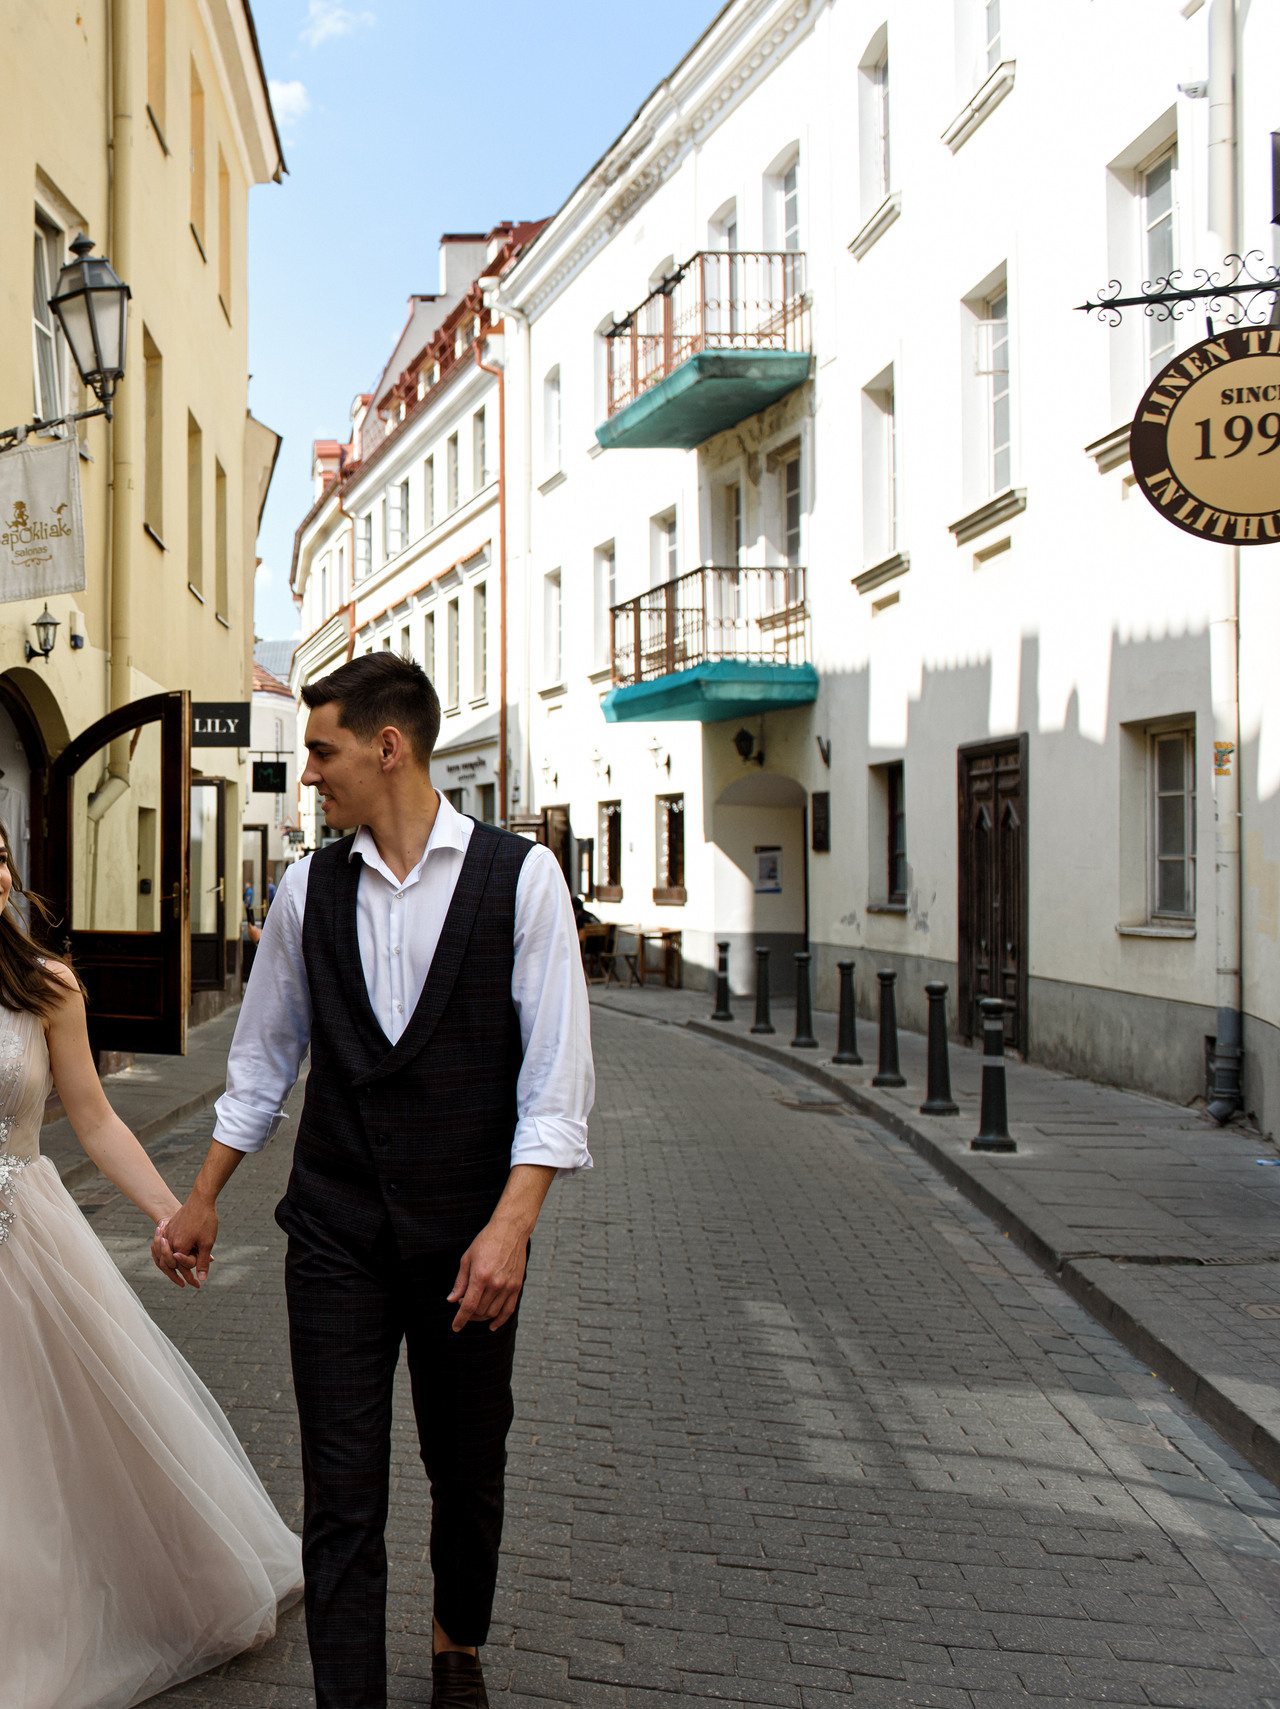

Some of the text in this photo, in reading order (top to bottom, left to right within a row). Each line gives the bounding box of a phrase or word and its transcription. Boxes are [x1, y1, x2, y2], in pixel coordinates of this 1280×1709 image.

[1142, 338, 1231, 426] LINEN
[1220, 384, 1280, 405] SINC
[1145, 468, 1185, 506] IN
[193, 718, 239, 733] LILY
